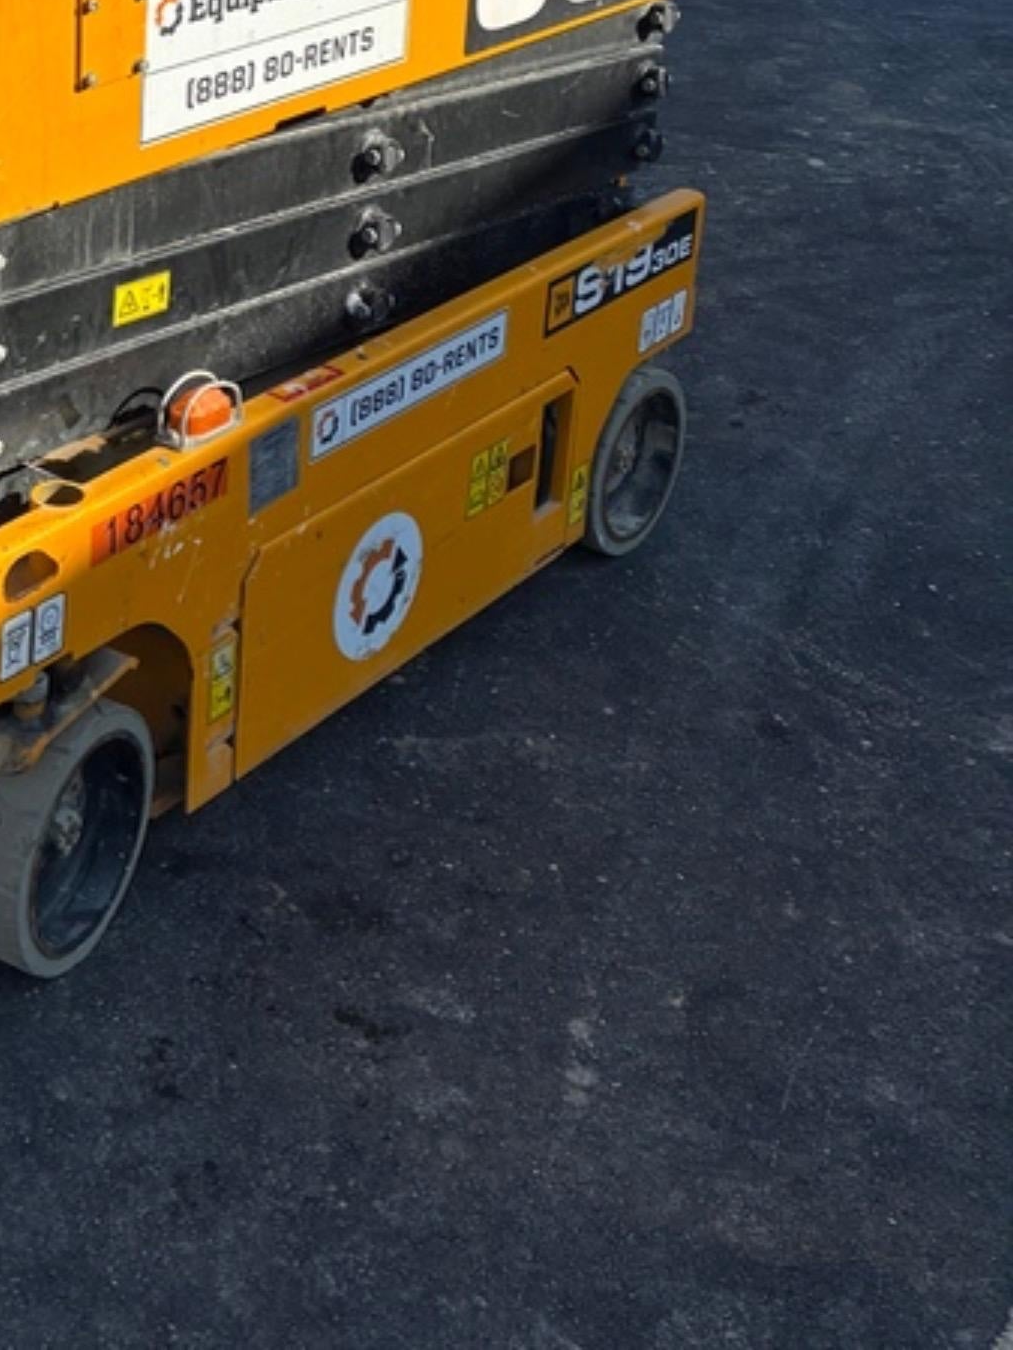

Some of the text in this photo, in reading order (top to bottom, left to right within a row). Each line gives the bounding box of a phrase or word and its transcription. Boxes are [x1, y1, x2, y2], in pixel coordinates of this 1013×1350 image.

[185, 25, 376, 109] (888) 80-RENTS
[348, 374, 406, 427] (888)
[410, 325, 500, 392] 80-RENTS
[106, 455, 230, 555] 184657
